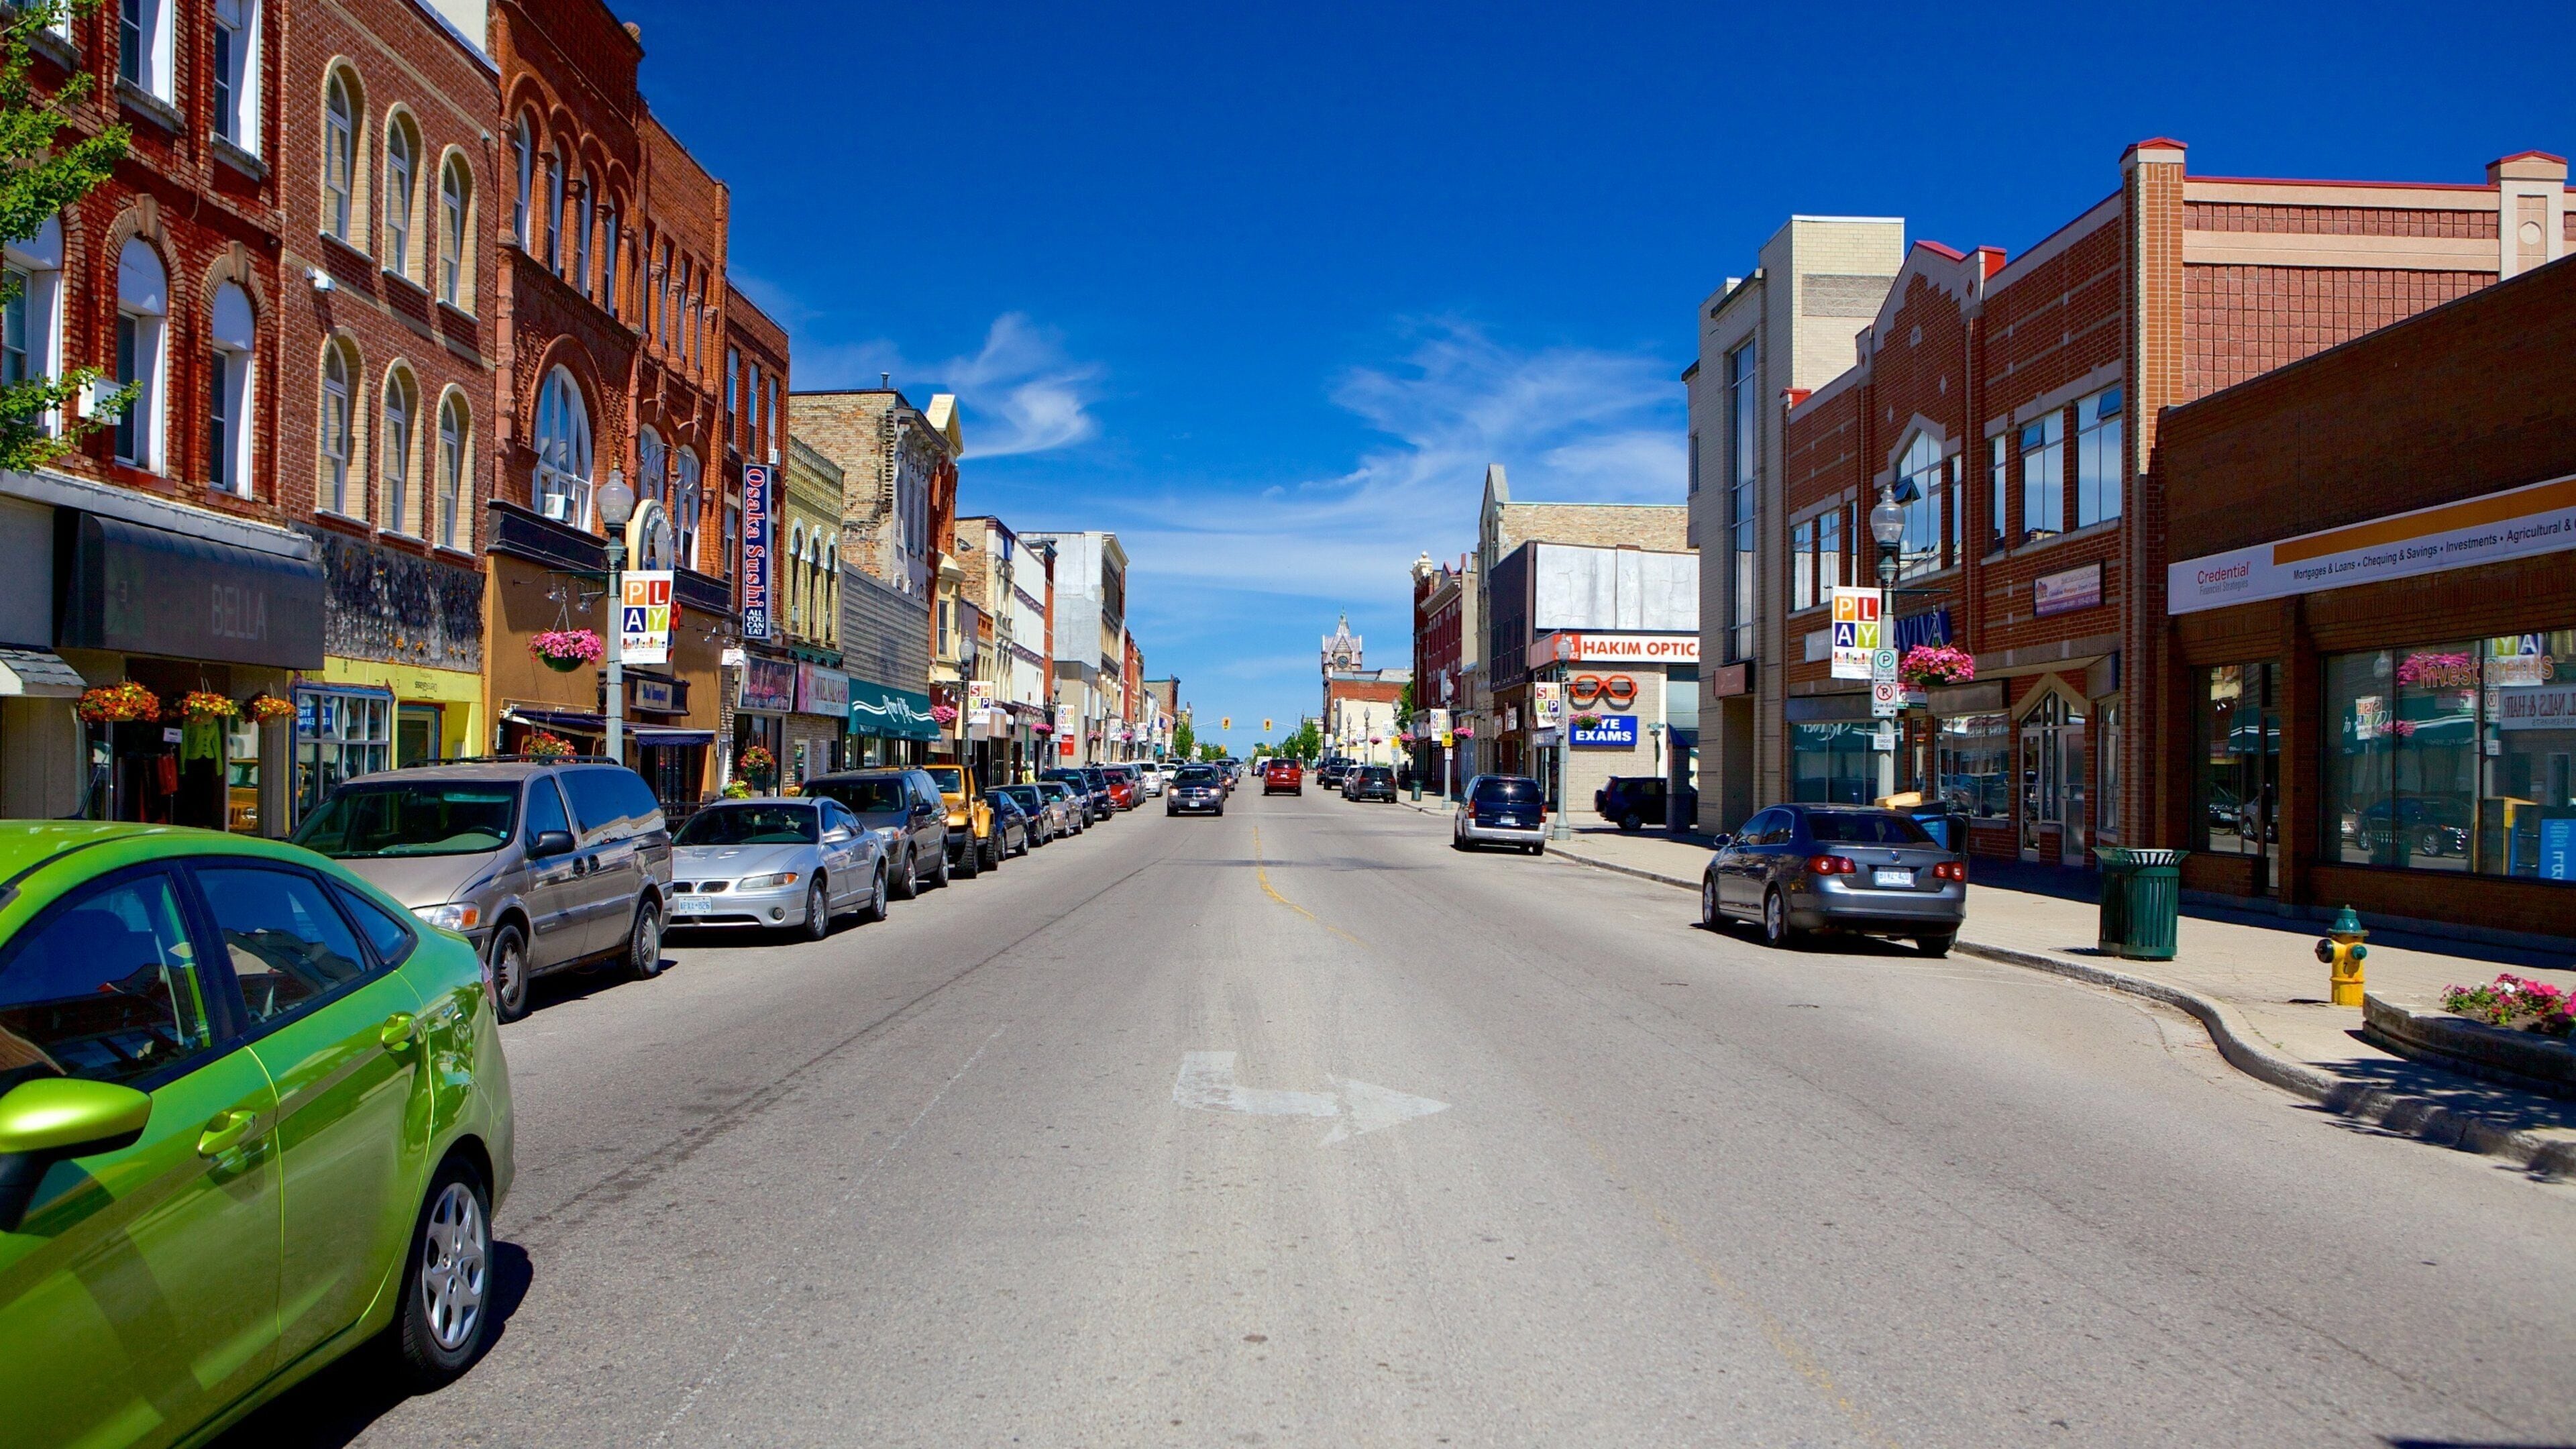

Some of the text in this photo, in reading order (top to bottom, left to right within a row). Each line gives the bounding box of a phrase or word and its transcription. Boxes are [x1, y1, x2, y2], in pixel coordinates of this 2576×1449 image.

[746, 468, 765, 608] Osaka Sushi
[2294, 519, 2571, 580] Mortgages & Loans Chequing & Savings Investments Agricultural &
[2197, 561, 2249, 584] Credential
[2200, 579, 2249, 596] Financial Strategies
[211, 584, 268, 641] BELLA
[1583, 641, 1641, 655] HAKIM
[2419, 655, 2555, 689] Investments
[1595, 718, 1620, 729] YE
[1576, 731, 1632, 741] EXAMS
